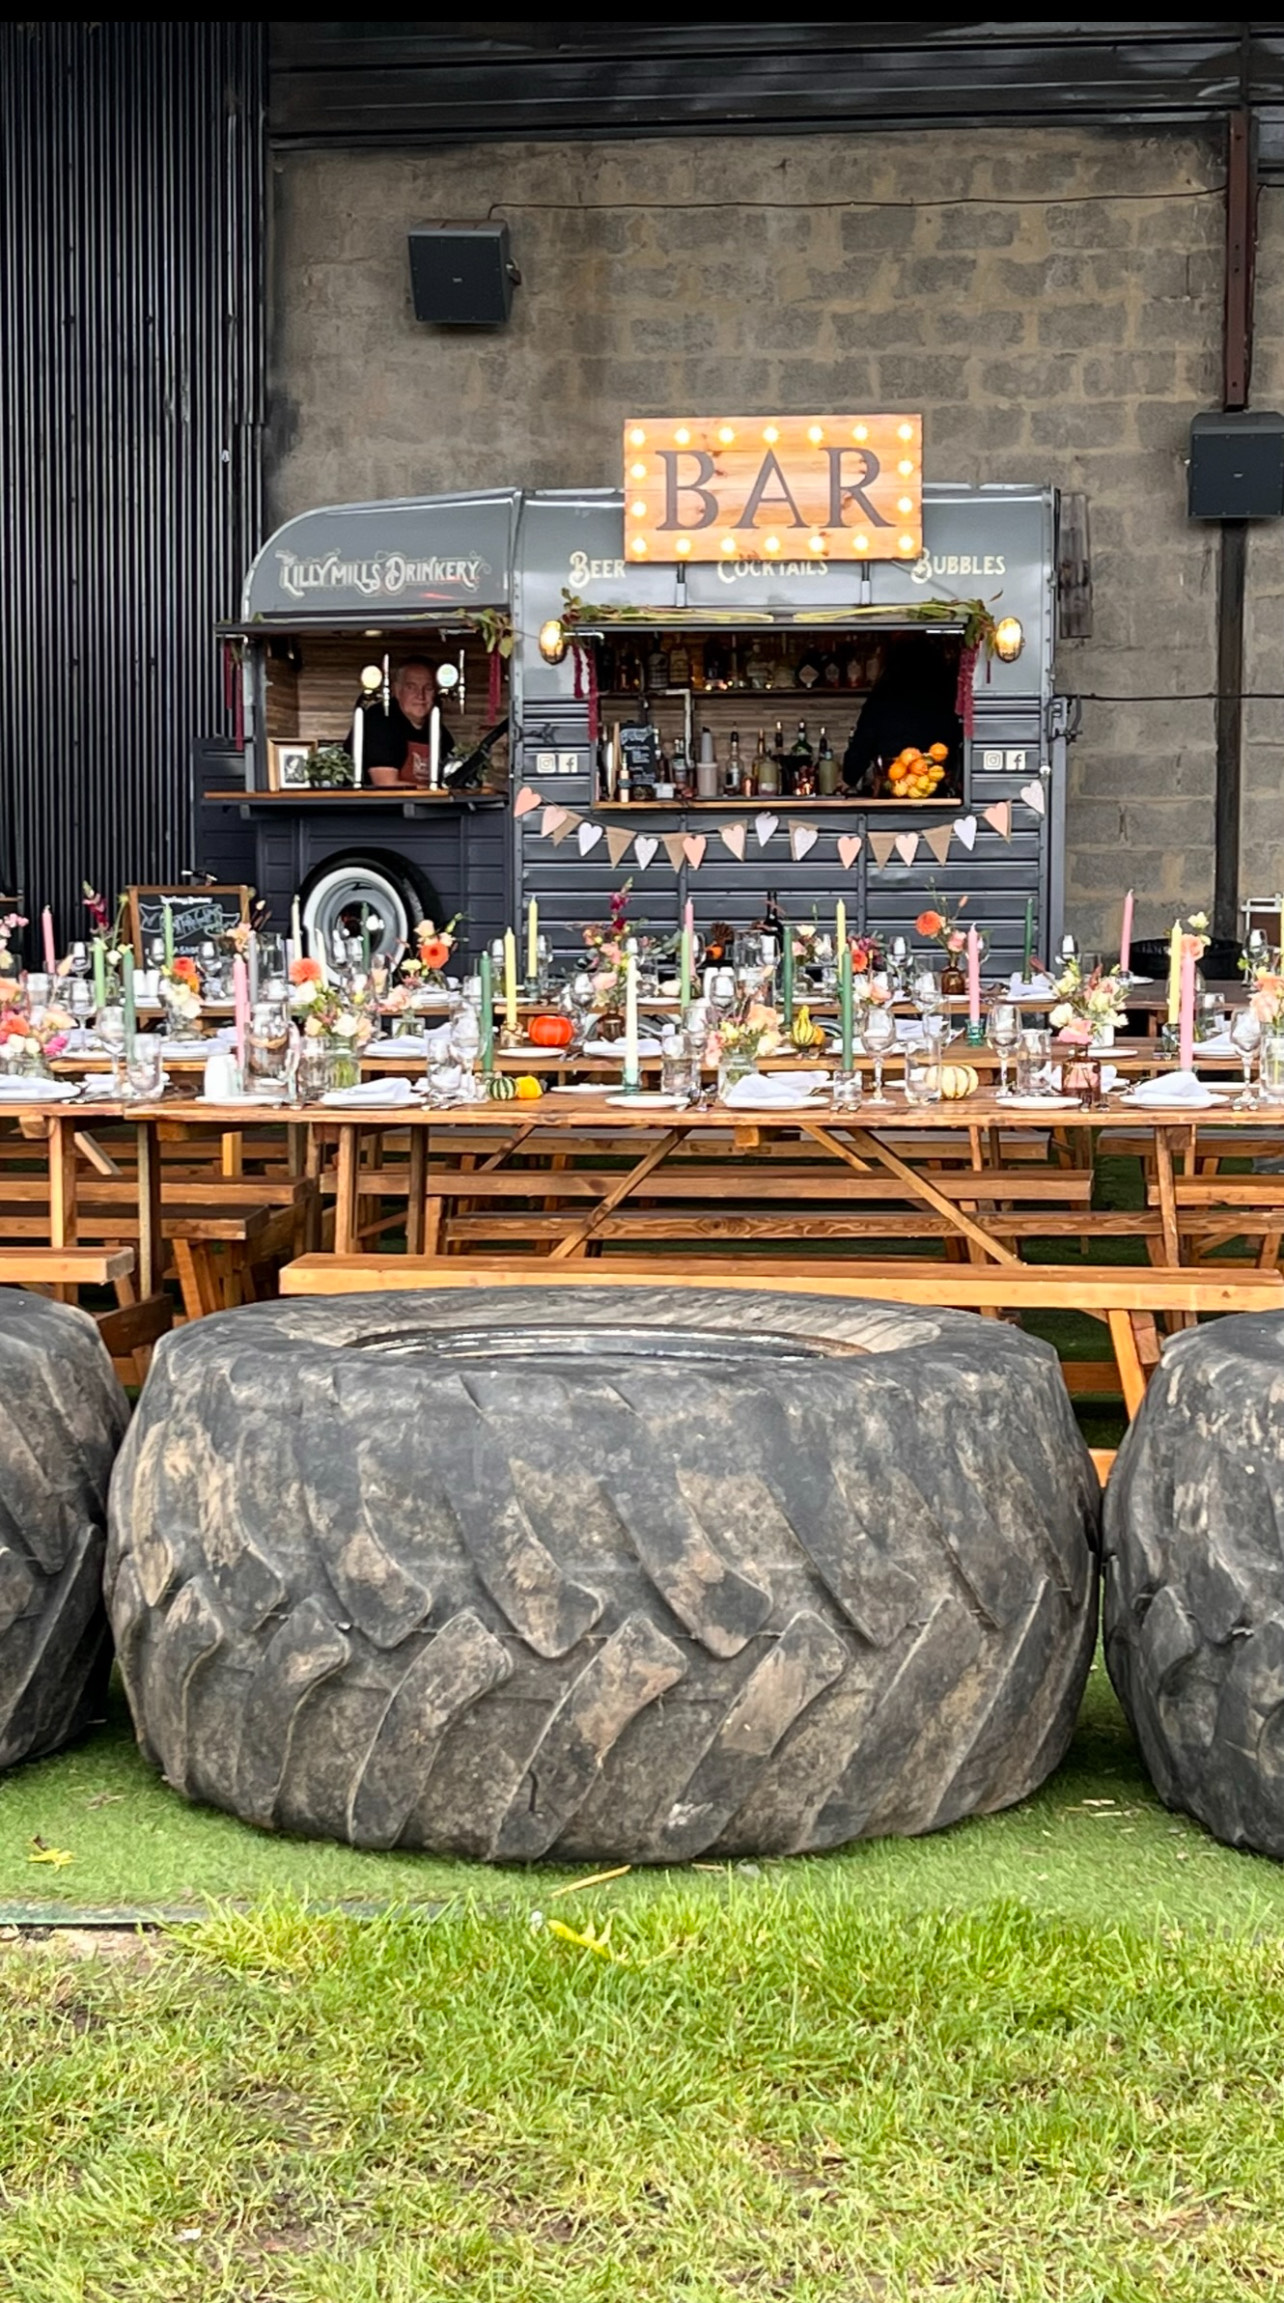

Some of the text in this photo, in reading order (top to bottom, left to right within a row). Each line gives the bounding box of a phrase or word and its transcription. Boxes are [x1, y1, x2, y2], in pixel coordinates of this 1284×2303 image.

[655, 447, 897, 531] BAR
[384, 553, 480, 592] DRINKERY
[569, 547, 1006, 589] BEER COCKTAILS BUBBLES
